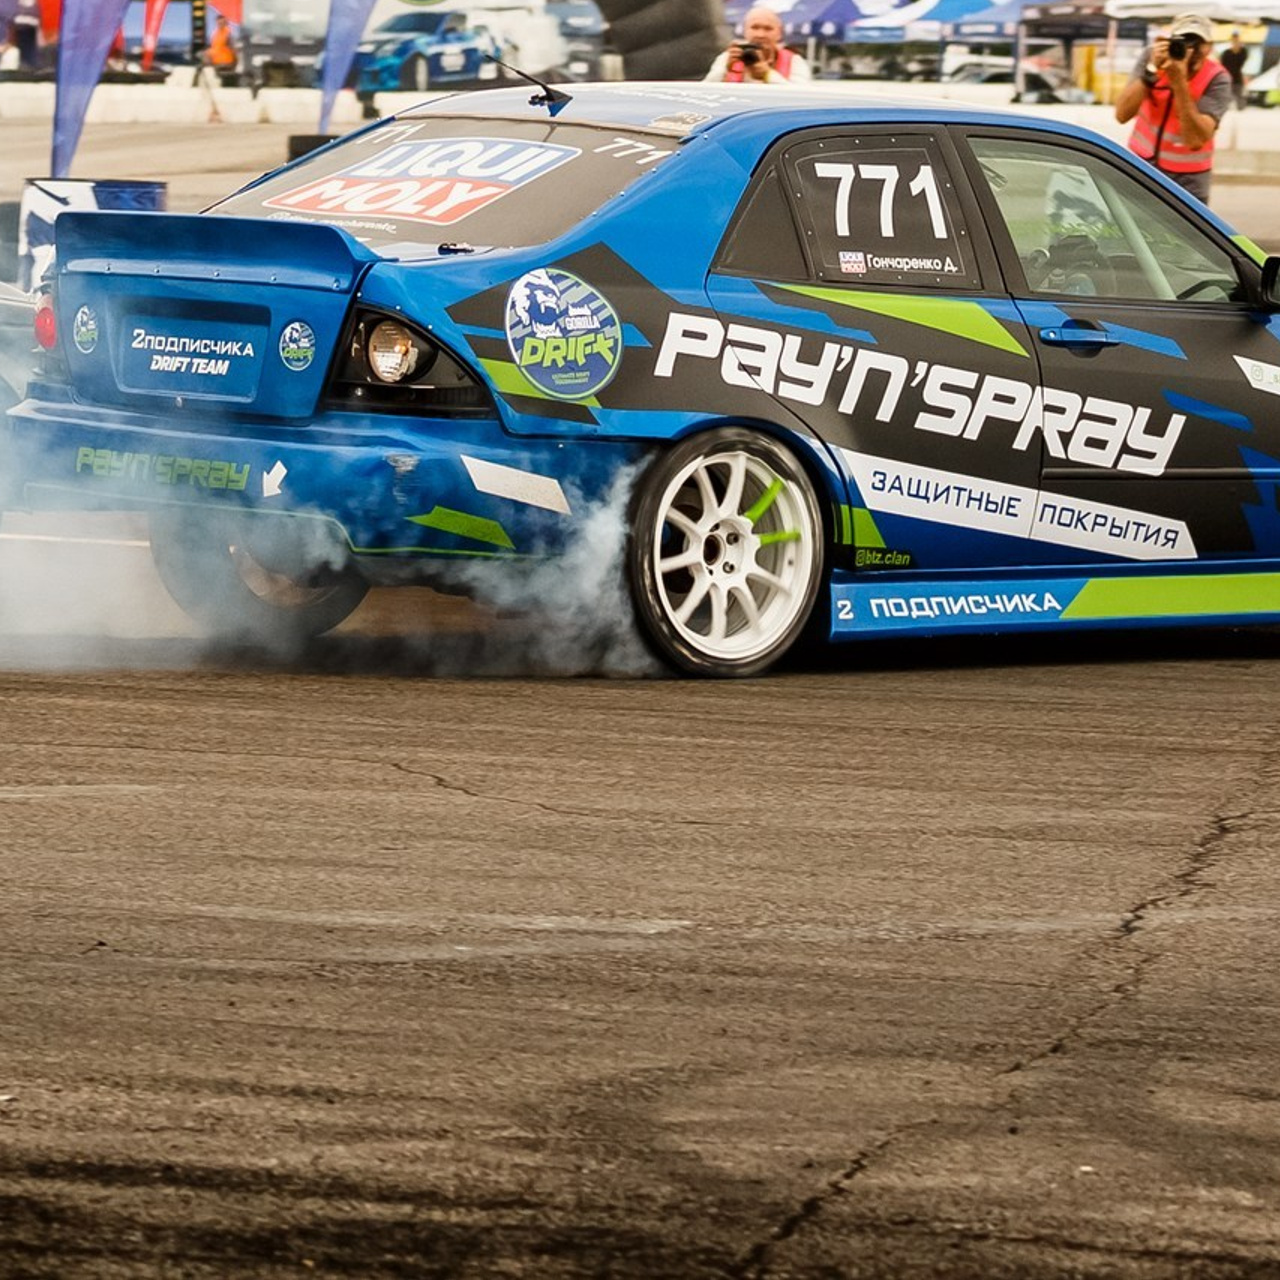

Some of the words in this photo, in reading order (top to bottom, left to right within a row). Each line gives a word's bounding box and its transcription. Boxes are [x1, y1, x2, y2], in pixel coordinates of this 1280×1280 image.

[349, 140, 565, 181] LIQUI
[593, 137, 673, 164] 771
[281, 179, 506, 218] MOLY
[814, 162, 948, 239] 771
[866, 254, 942, 271] Гончаренко
[150, 354, 190, 372] DRIFT
[191, 356, 231, 376] TEAM
[520, 332, 615, 368] DRIFT
[871, 470, 1022, 518] ЗАЩИТНЫЕ
[1038, 503, 1180, 550] ПОКРЫТИЯ
[837, 600, 854, 619] 2
[869, 592, 1063, 619] ПОДПИСЧИКА
